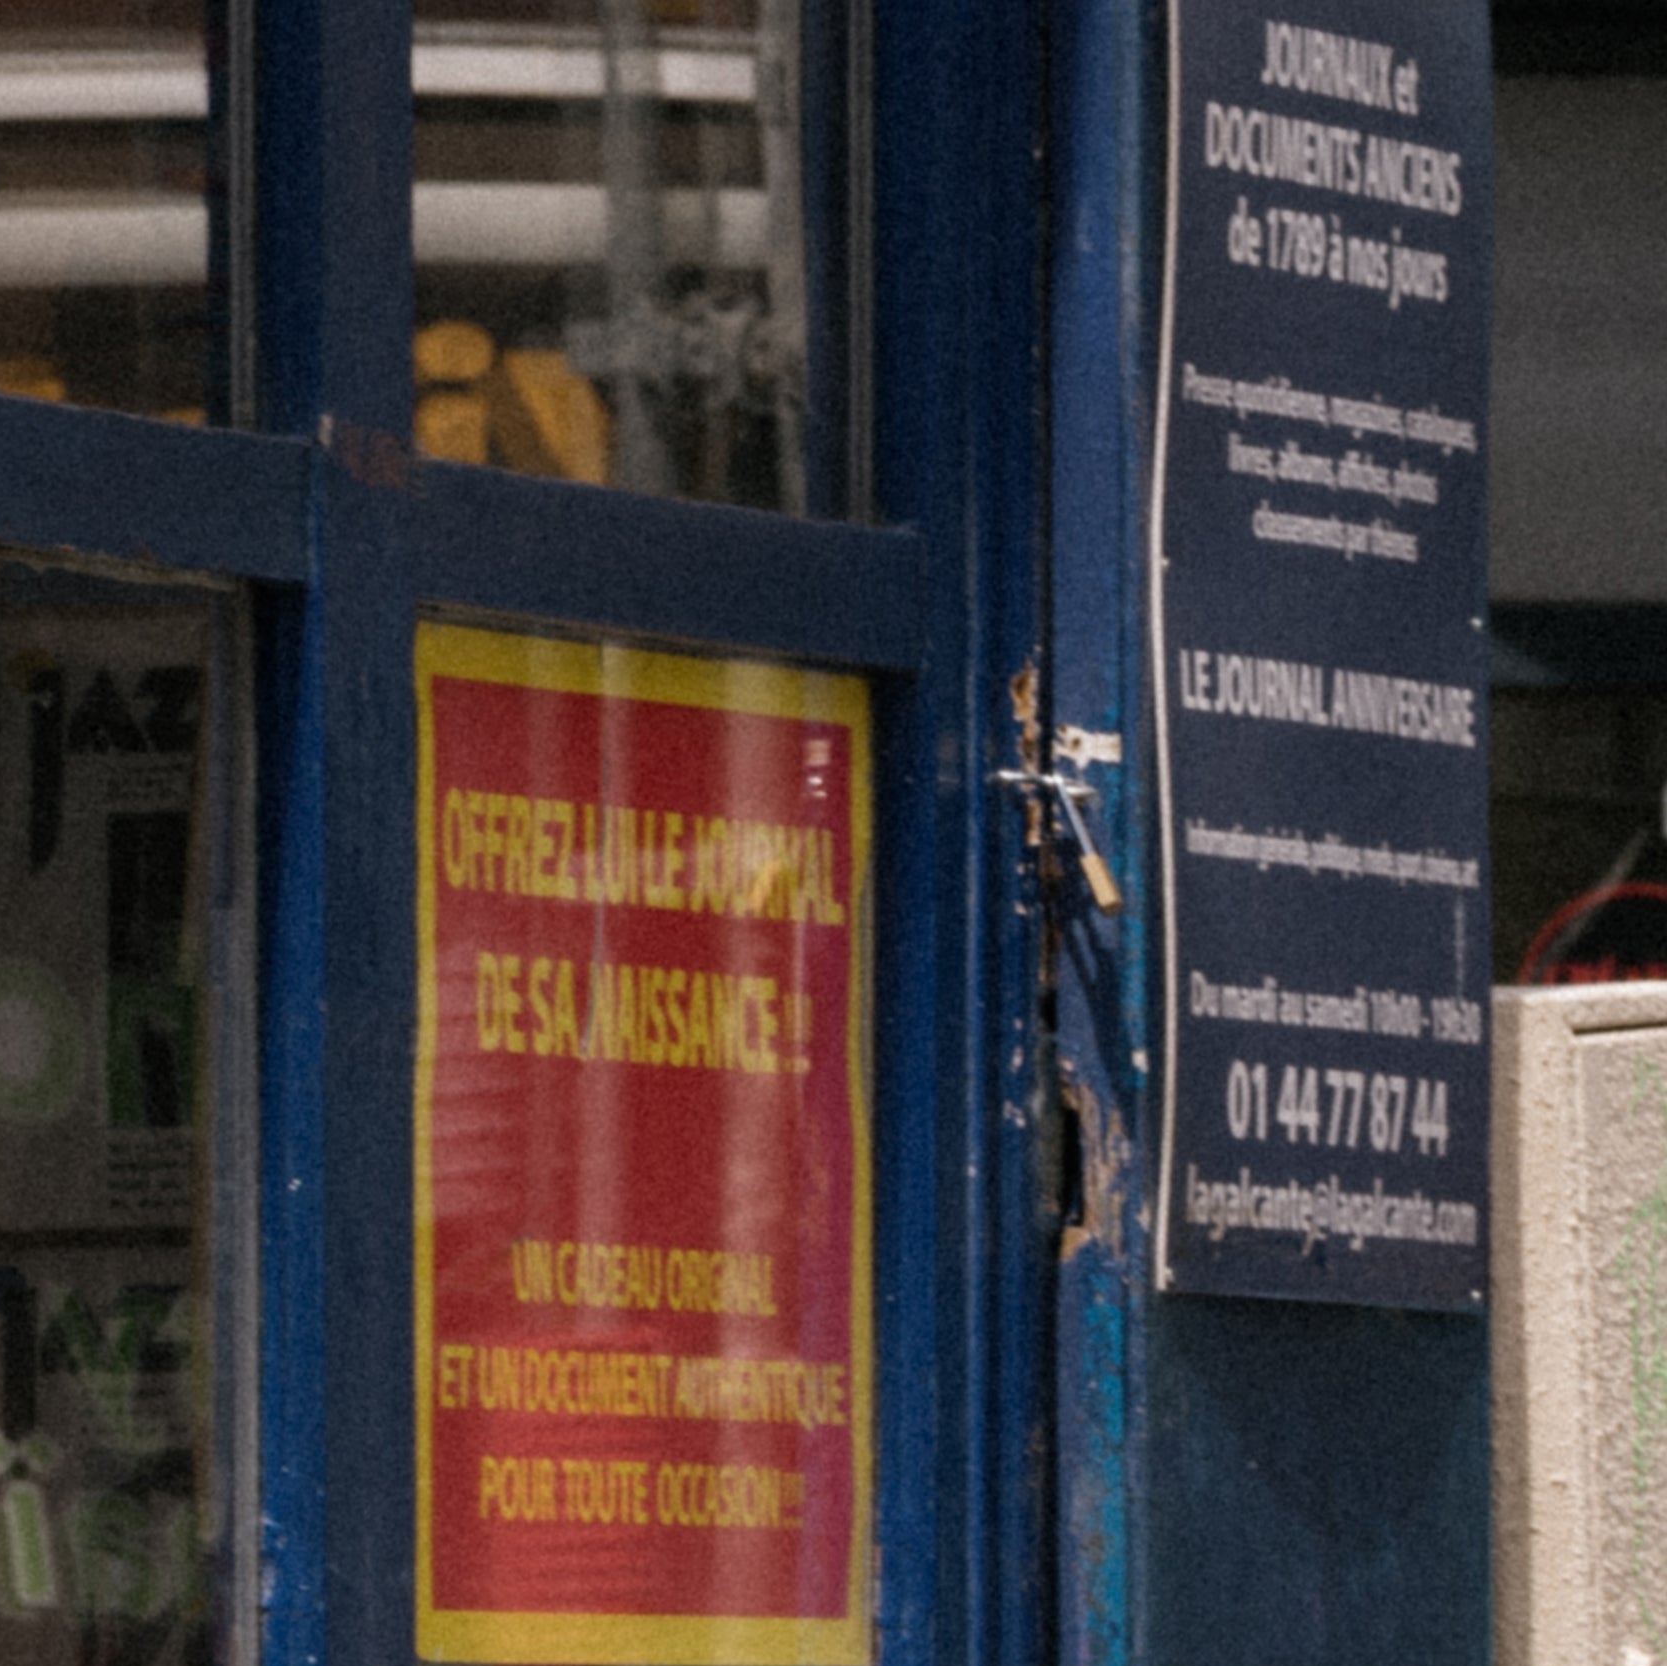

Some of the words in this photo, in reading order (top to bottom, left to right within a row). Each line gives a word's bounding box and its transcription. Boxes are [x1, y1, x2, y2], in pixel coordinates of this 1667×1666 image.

[1260, 20, 1394, 110] JOURNAUX
[1394, 58, 1420, 116] et
[1205, 100, 1361, 196] DOCUMENTS
[1364, 134, 1462, 217] ANCIENS
[1227, 195, 1262, 267] de
[1265, 207, 1327, 278] 1789
[1328, 213, 1344, 282] à
[1348, 235, 1389, 291] nos
[1388, 226, 1448, 311] jours
[1179, 647, 1212, 711] LE
[1214, 653, 1330, 726] JOURNAL
[1331, 668, 1476, 748] ANNIVERSAIRE
[442, 786, 577, 900] OFFREZ
[583, 802, 638, 906] LUI
[643, 809, 685, 911] LE
[689, 814, 845, 926] JOURNAL
[476, 950, 526, 1055] DE
[528, 956, 579, 1058] SA
[588, 961, 779, 1074] NAISSANCE
[1189, 969, 1221, 1019] Du
[1221, 976, 1278, 1024] mardi
[1278, 991, 1304, 1026] au
[1303, 985, 1369, 1032] samedi
[1226, 1058, 1268, 1141] 01
[1276, 1063, 1320, 1145] 44
[1324, 1068, 1366, 1148] 77
[1368, 1072, 1408, 1151] 87
[1410, 1077, 1450, 1157] 44
[1185, 1162, 1478, 1254] lagalcante@lagalcante.com
[510, 1239, 554, 1304] UN
[555, 1240, 663, 1311] CADEAU
[665, 1247, 778, 1317] ORIGINAL
[439, 1343, 475, 1410] ET
[476, 1346, 522, 1411] UN
[523, 1348, 672, 1419] DOCUMENT
[673, 1355, 847, 1432] AUTHENTIQUE
[478, 1454, 558, 1522] POUR
[561, 1459, 649, 1526] TOUTE
